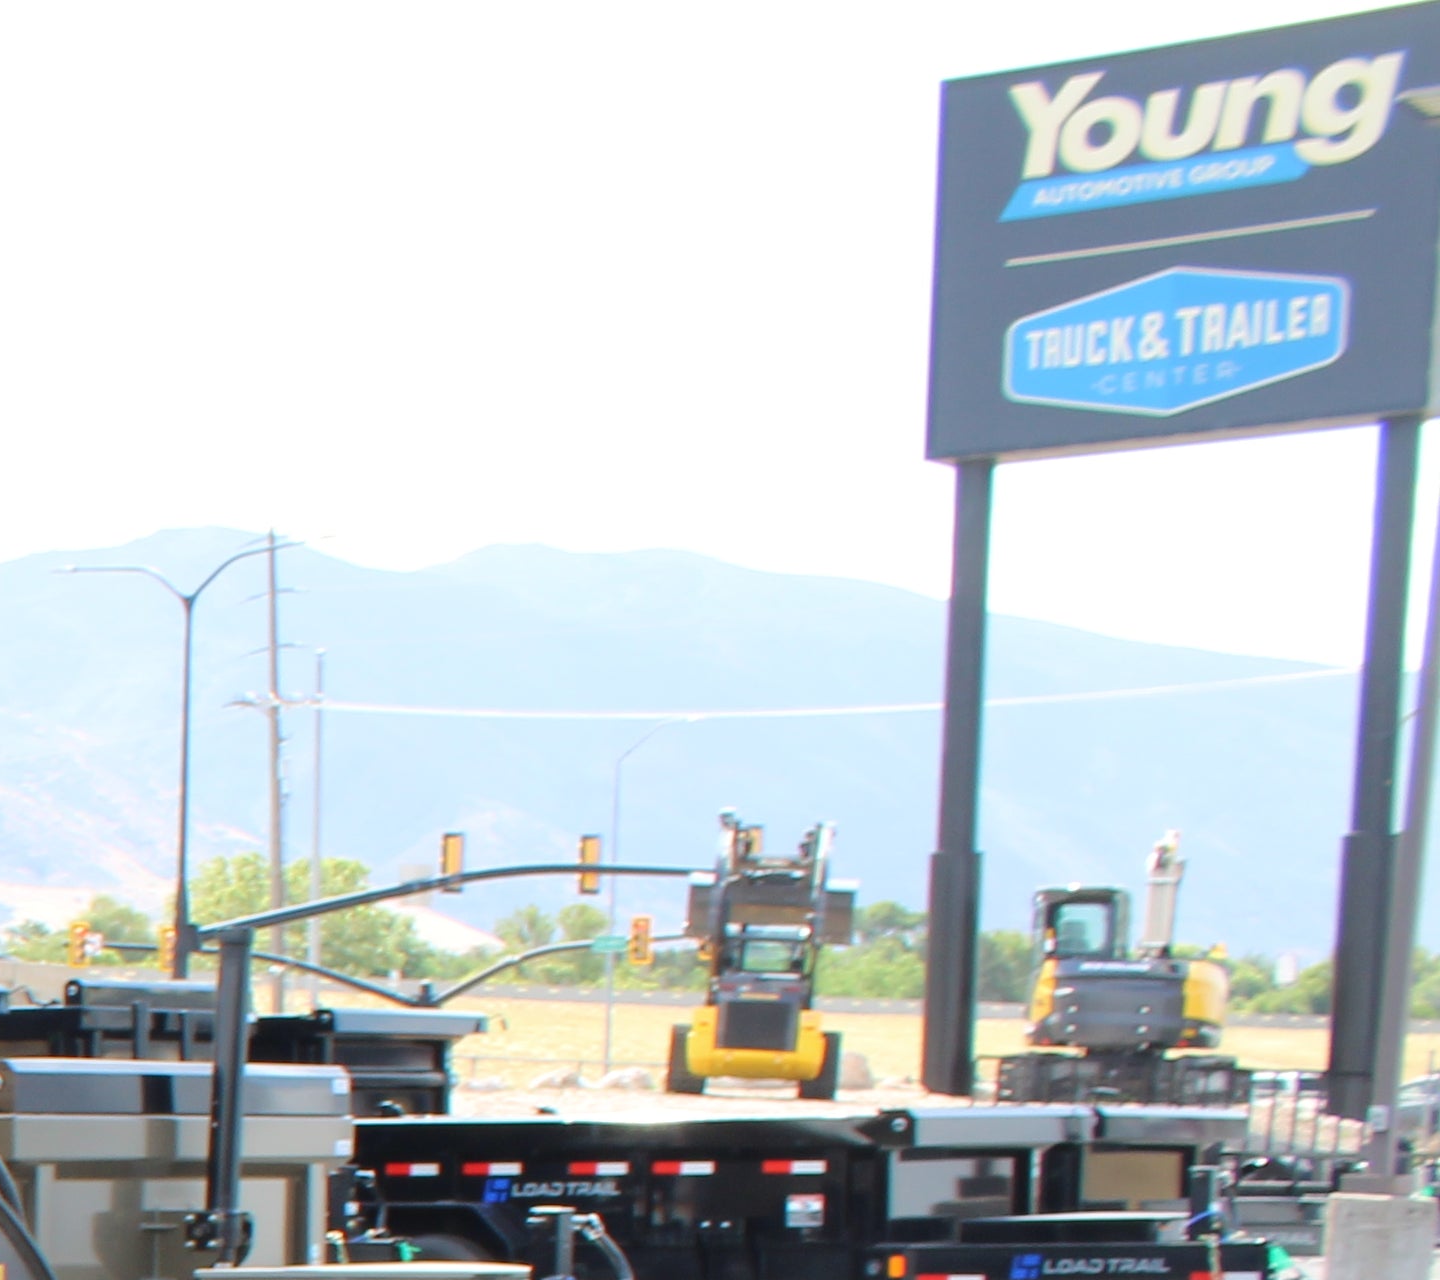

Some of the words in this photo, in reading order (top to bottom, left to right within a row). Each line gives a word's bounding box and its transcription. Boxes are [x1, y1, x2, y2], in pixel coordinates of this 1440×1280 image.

[1009, 51, 1405, 179] Young
[1033, 166, 1183, 206] AUTOMOTIVE
[1189, 155, 1276, 186] GROUP
[1025, 316, 1134, 370] TRUCK
[1138, 310, 1170, 359] &
[1176, 294, 1332, 357] TRAILER
[1095, 362, 1234, 396] CENTER
[511, 1182, 565, 1197] LOAD
[567, 1181, 622, 1196] TRAIL
[1042, 1258, 1105, 1274] LOAD
[1107, 1257, 1171, 1274] TRAIL
